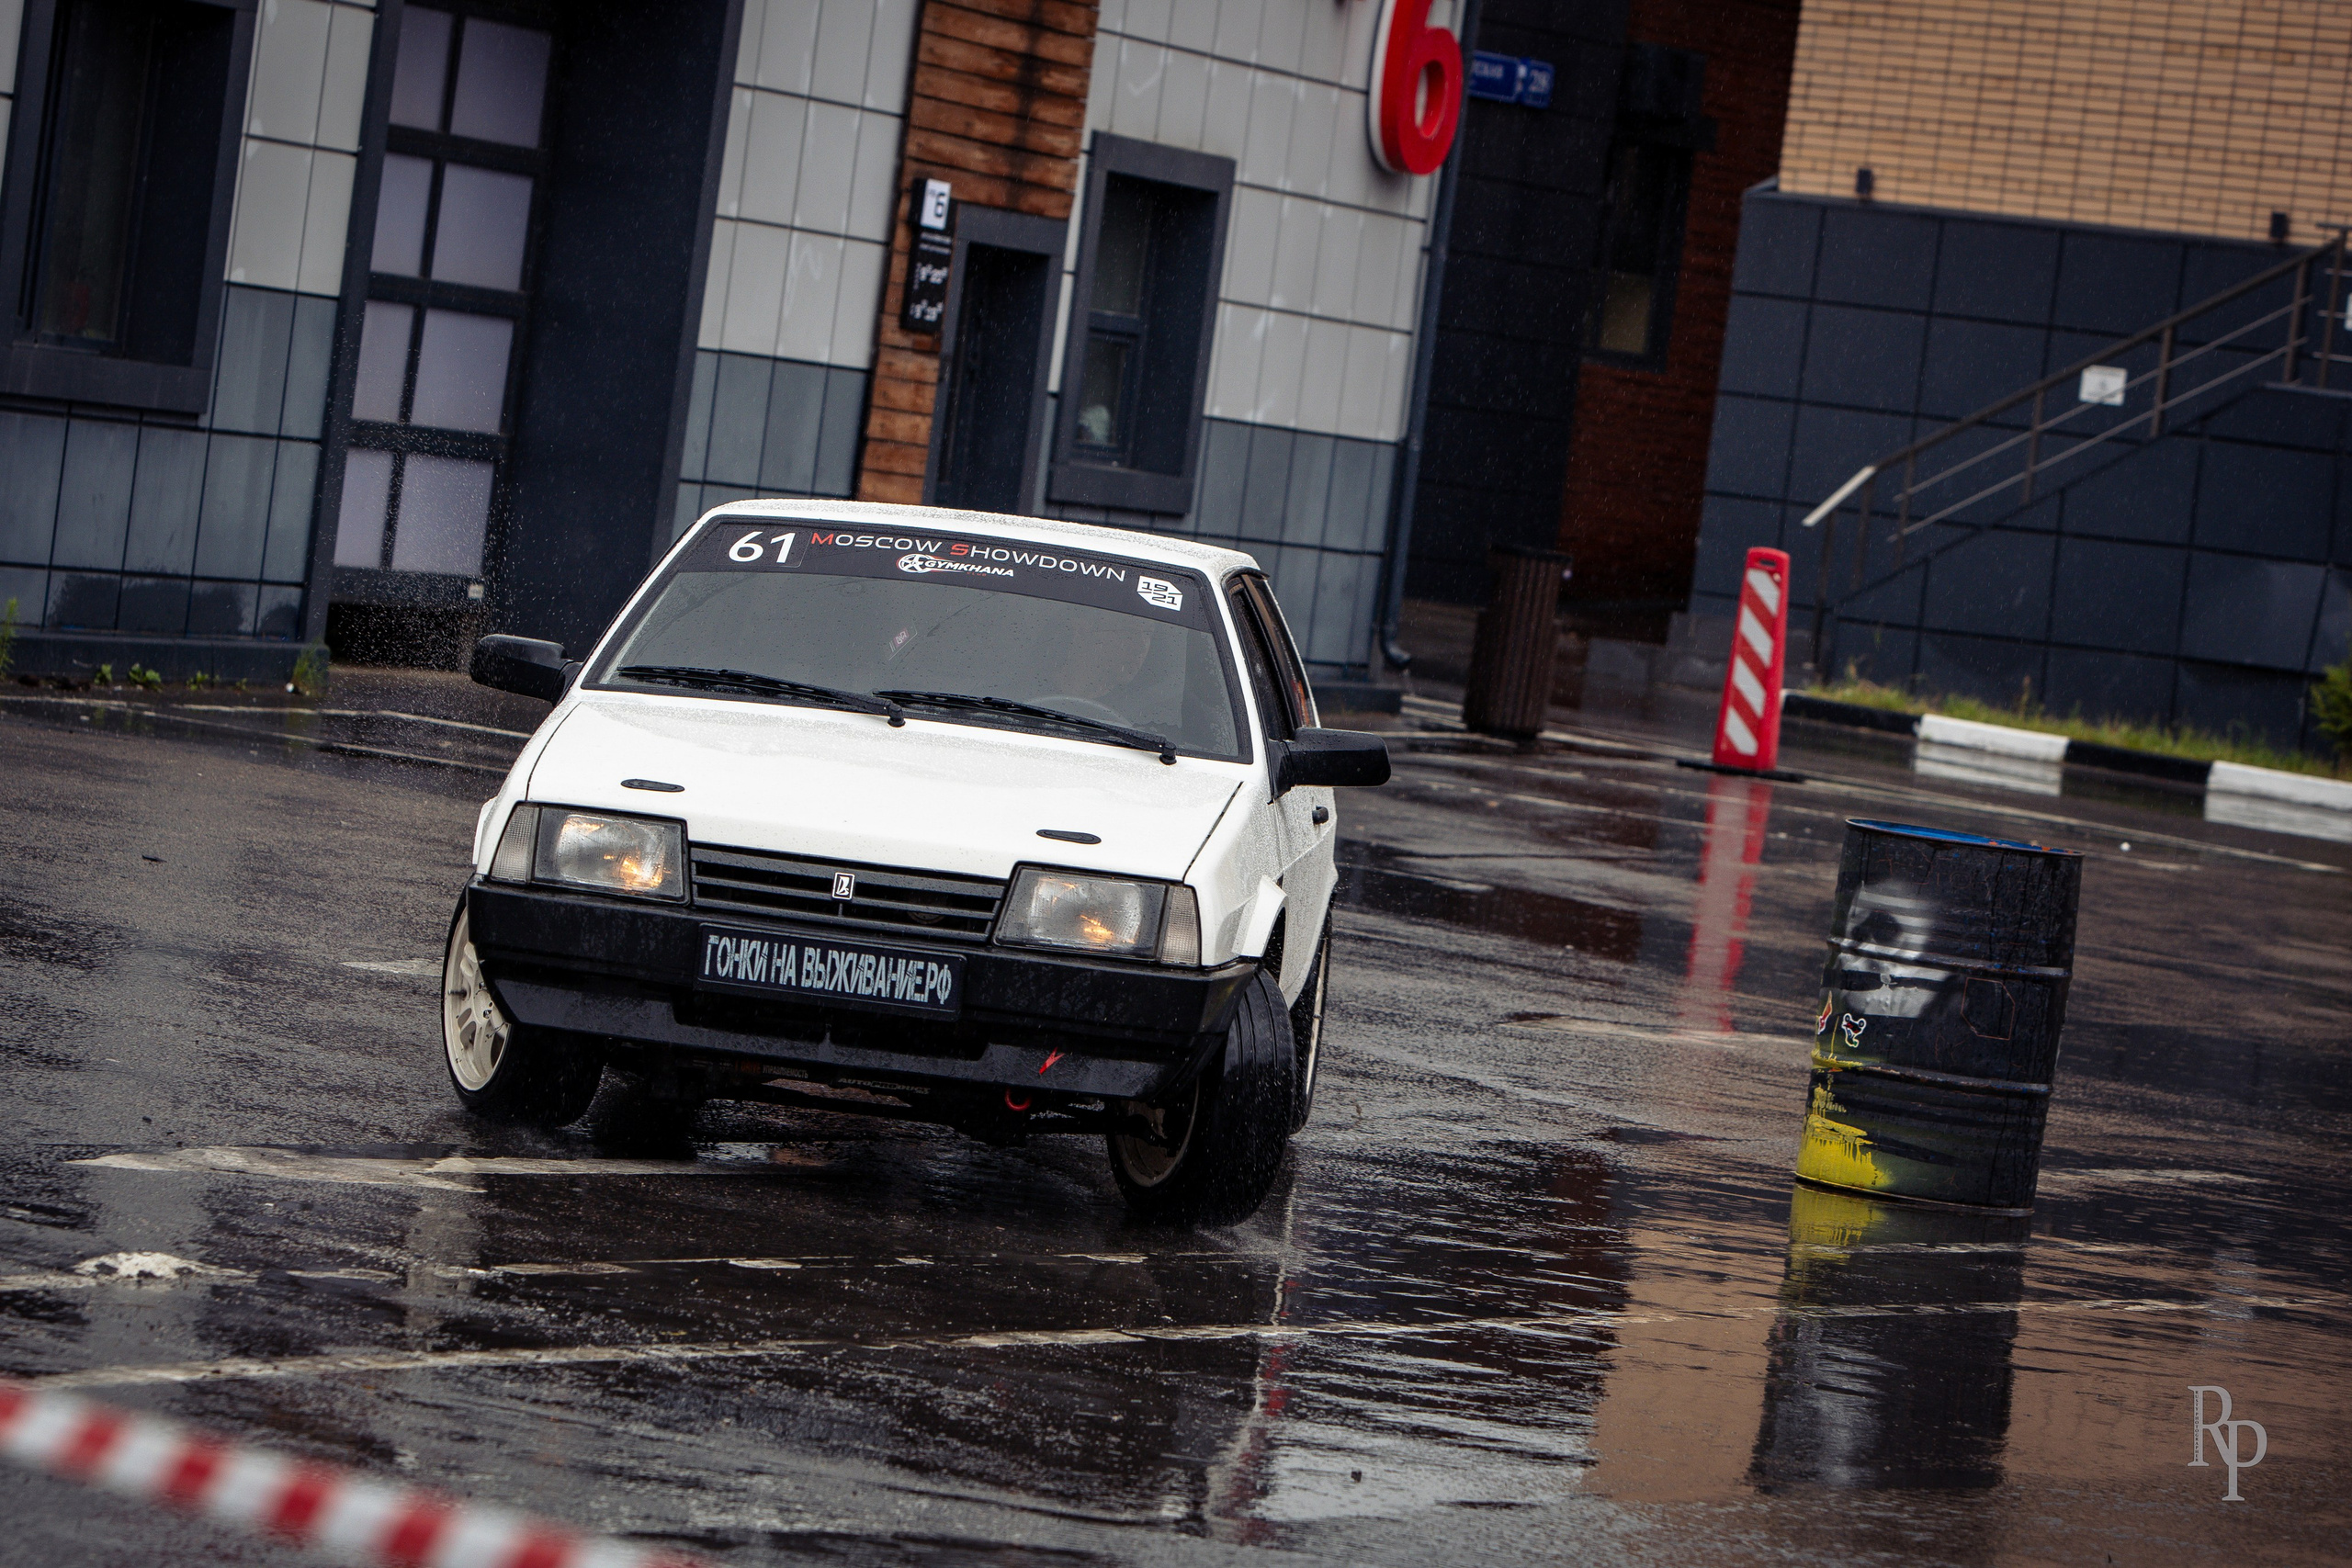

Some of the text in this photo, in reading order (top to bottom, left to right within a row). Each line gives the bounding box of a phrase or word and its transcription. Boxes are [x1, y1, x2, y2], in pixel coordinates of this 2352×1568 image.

[1381, 0, 1464, 176] 6
[934, 192, 946, 219] 6
[729, 531, 797, 564] 61
[810, 532, 1126, 582] MOSCOW SHOWDOWN
[924, 559, 1014, 578] GYMKHANA
[1141, 581, 1169, 592] 19
[1151, 592, 1178, 606] 21
[704, 934, 769, 983] ГОНКИ
[770, 942, 797, 987] НА
